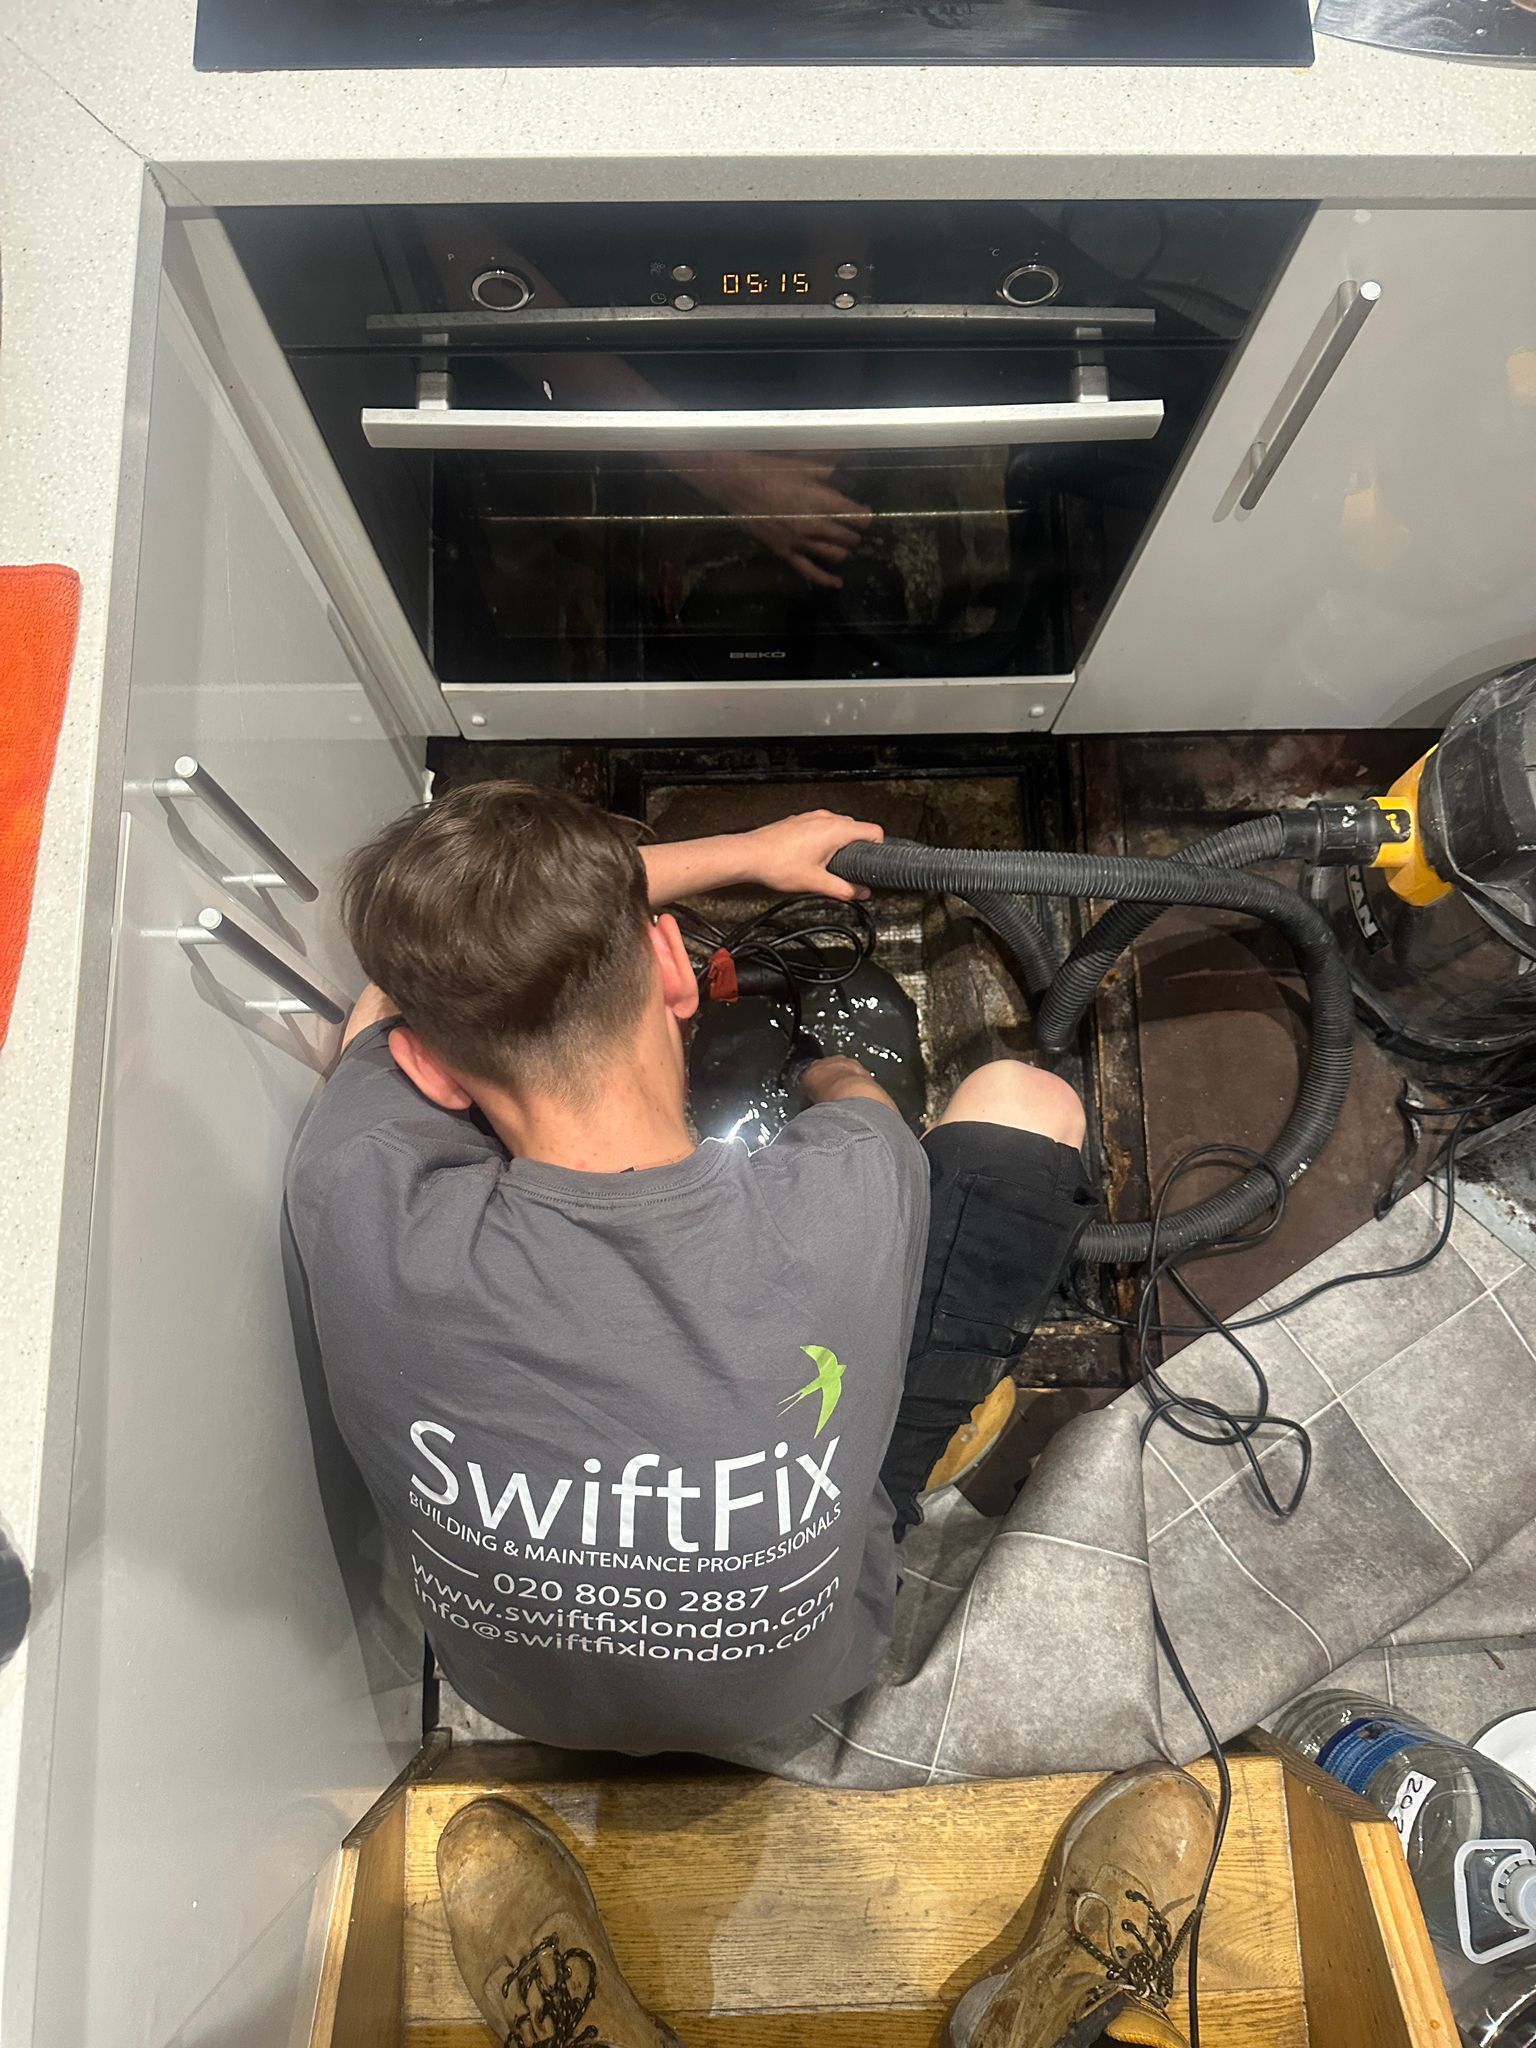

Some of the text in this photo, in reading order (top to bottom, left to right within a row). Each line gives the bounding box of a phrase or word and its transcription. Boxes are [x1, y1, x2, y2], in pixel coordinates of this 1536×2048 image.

[447, 253, 455, 261] P
[723, 273, 808, 294] 05:15
[408, 1419, 842, 1554] SwiftFix
[408, 1490, 842, 1573] BUILDING & MAINTENANCE PROFESSIONALS
[411, 1553, 840, 1639] www.swiftfixlondon.com
[414, 1577, 834, 1662] info@swiftfixlondon.com
[492, 1573, 770, 1613] 020 8050 2887
